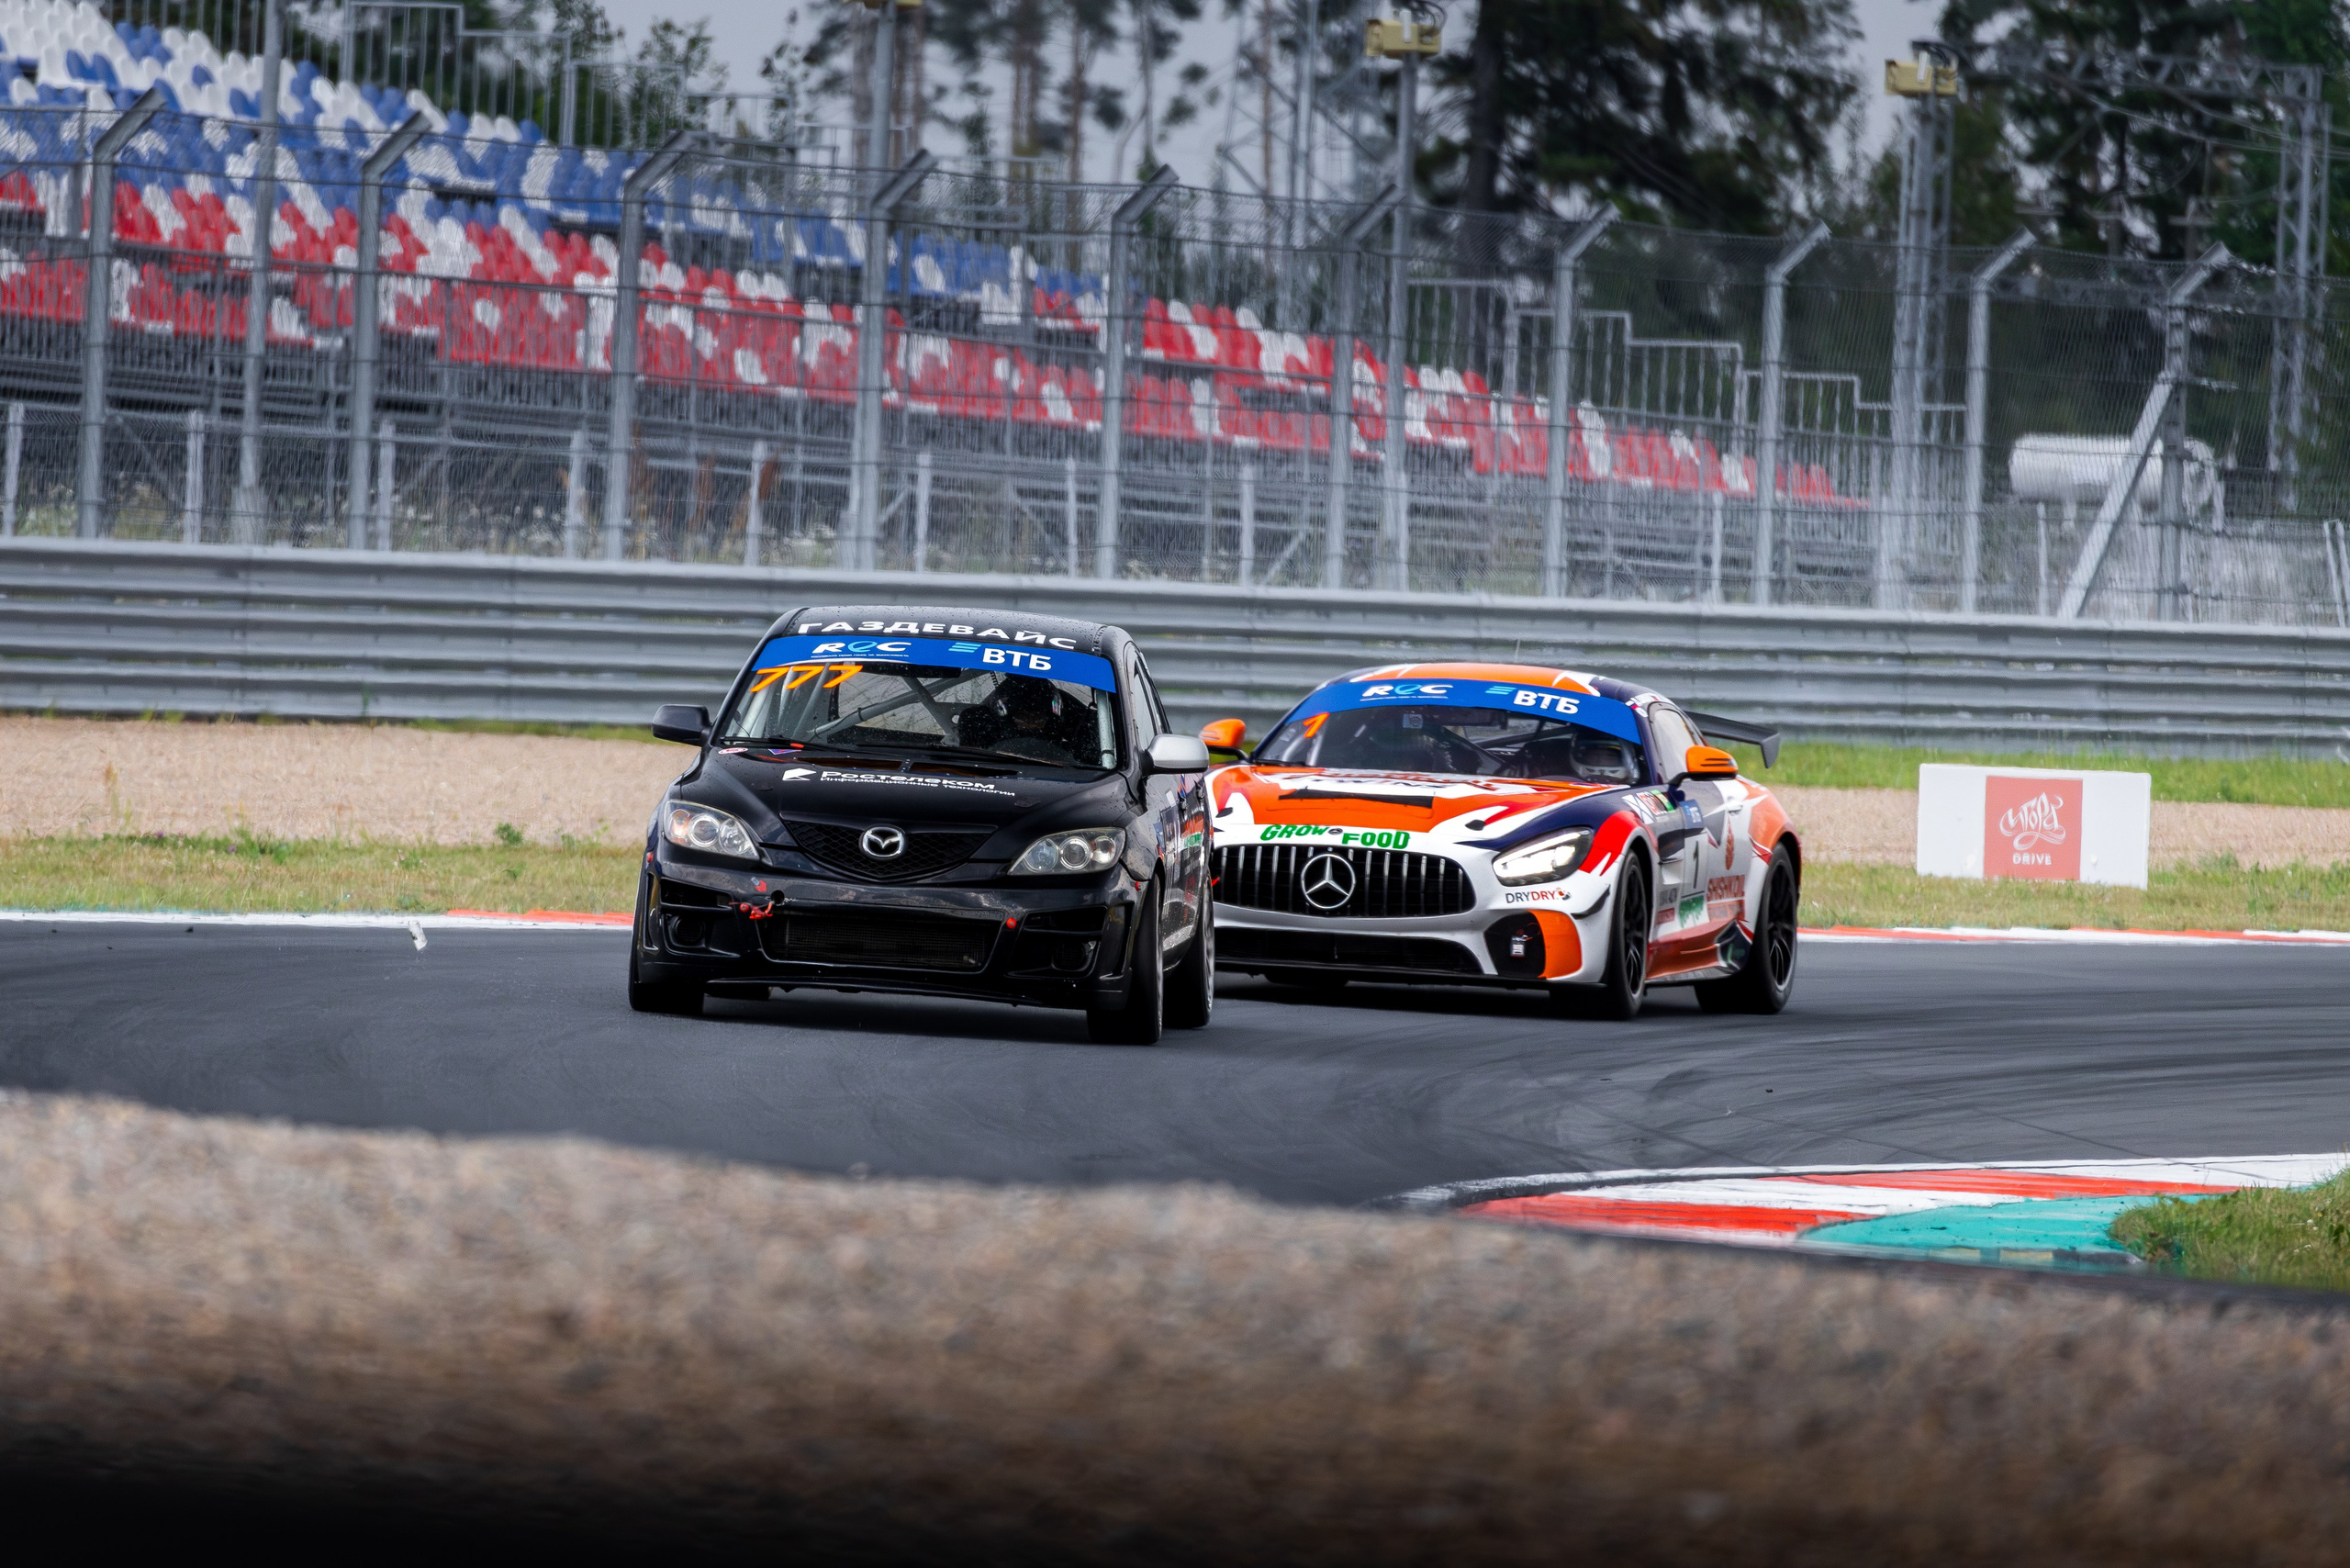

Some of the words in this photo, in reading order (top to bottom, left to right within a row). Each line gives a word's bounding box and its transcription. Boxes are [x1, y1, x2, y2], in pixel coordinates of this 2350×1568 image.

[798, 622, 1077, 650] ГАЗДЕВАЙС
[982, 647, 1052, 671] ВТБ
[749, 665, 864, 692] 777
[1513, 689, 1581, 715] ВТБ
[1303, 711, 1330, 738] 1
[820, 777, 939, 788] Информационные
[943, 784, 1016, 797] технологии
[821, 770, 995, 790] Ростелеком
[1341, 830, 1411, 849] FOOD
[1692, 840, 1700, 890] 1
[2012, 852, 2053, 866] DRIVE
